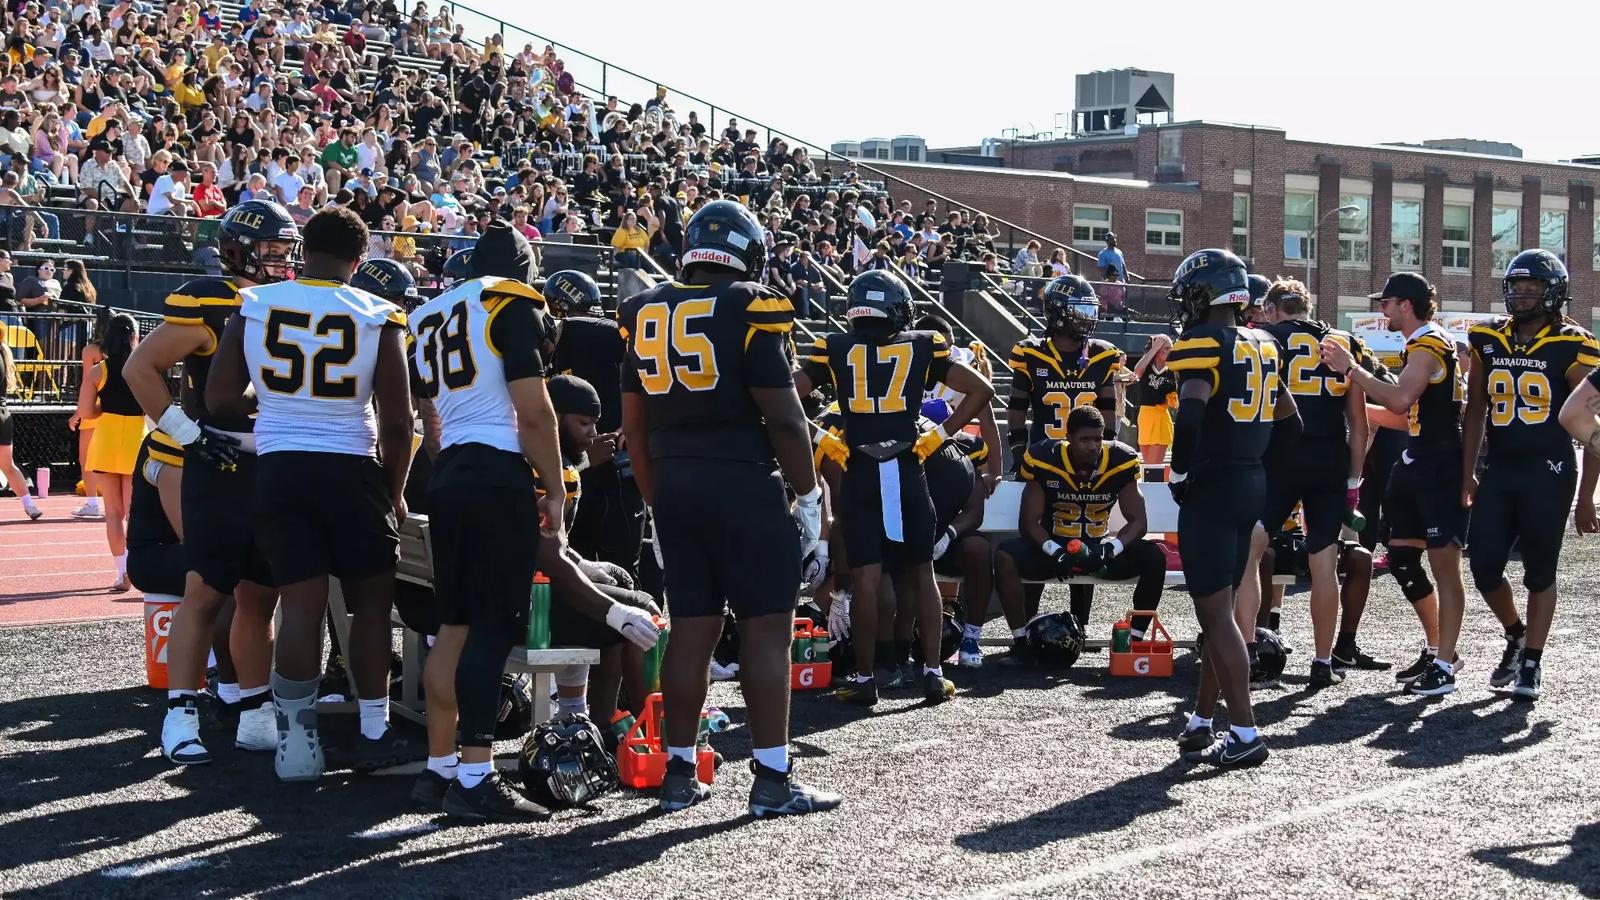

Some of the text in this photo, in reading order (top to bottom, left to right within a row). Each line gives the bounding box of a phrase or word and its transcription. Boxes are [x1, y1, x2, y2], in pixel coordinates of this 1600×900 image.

[231, 210, 265, 230] ILLE
[690, 251, 732, 264] Riddell
[1180, 254, 1209, 277] ILLE
[360, 261, 393, 286] VILLE
[554, 276, 585, 303] VILLE
[1051, 282, 1076, 298] ILLE
[260, 306, 359, 401] 52
[416, 300, 479, 401] 38
[634, 296, 721, 395] 95
[1491, 356, 1547, 371] MARAUDERS
[846, 341, 914, 414] 17
[1045, 380, 1096, 390] MARAUDERS
[1227, 339, 1279, 423] 32
[1487, 368, 1552, 427] 89
[1056, 491, 1111, 501] MARAUDERS
[1052, 501, 1109, 538] 25
[153, 609, 174, 637] G
[799, 667, 814, 687] G
[1133, 656, 1150, 675] G
